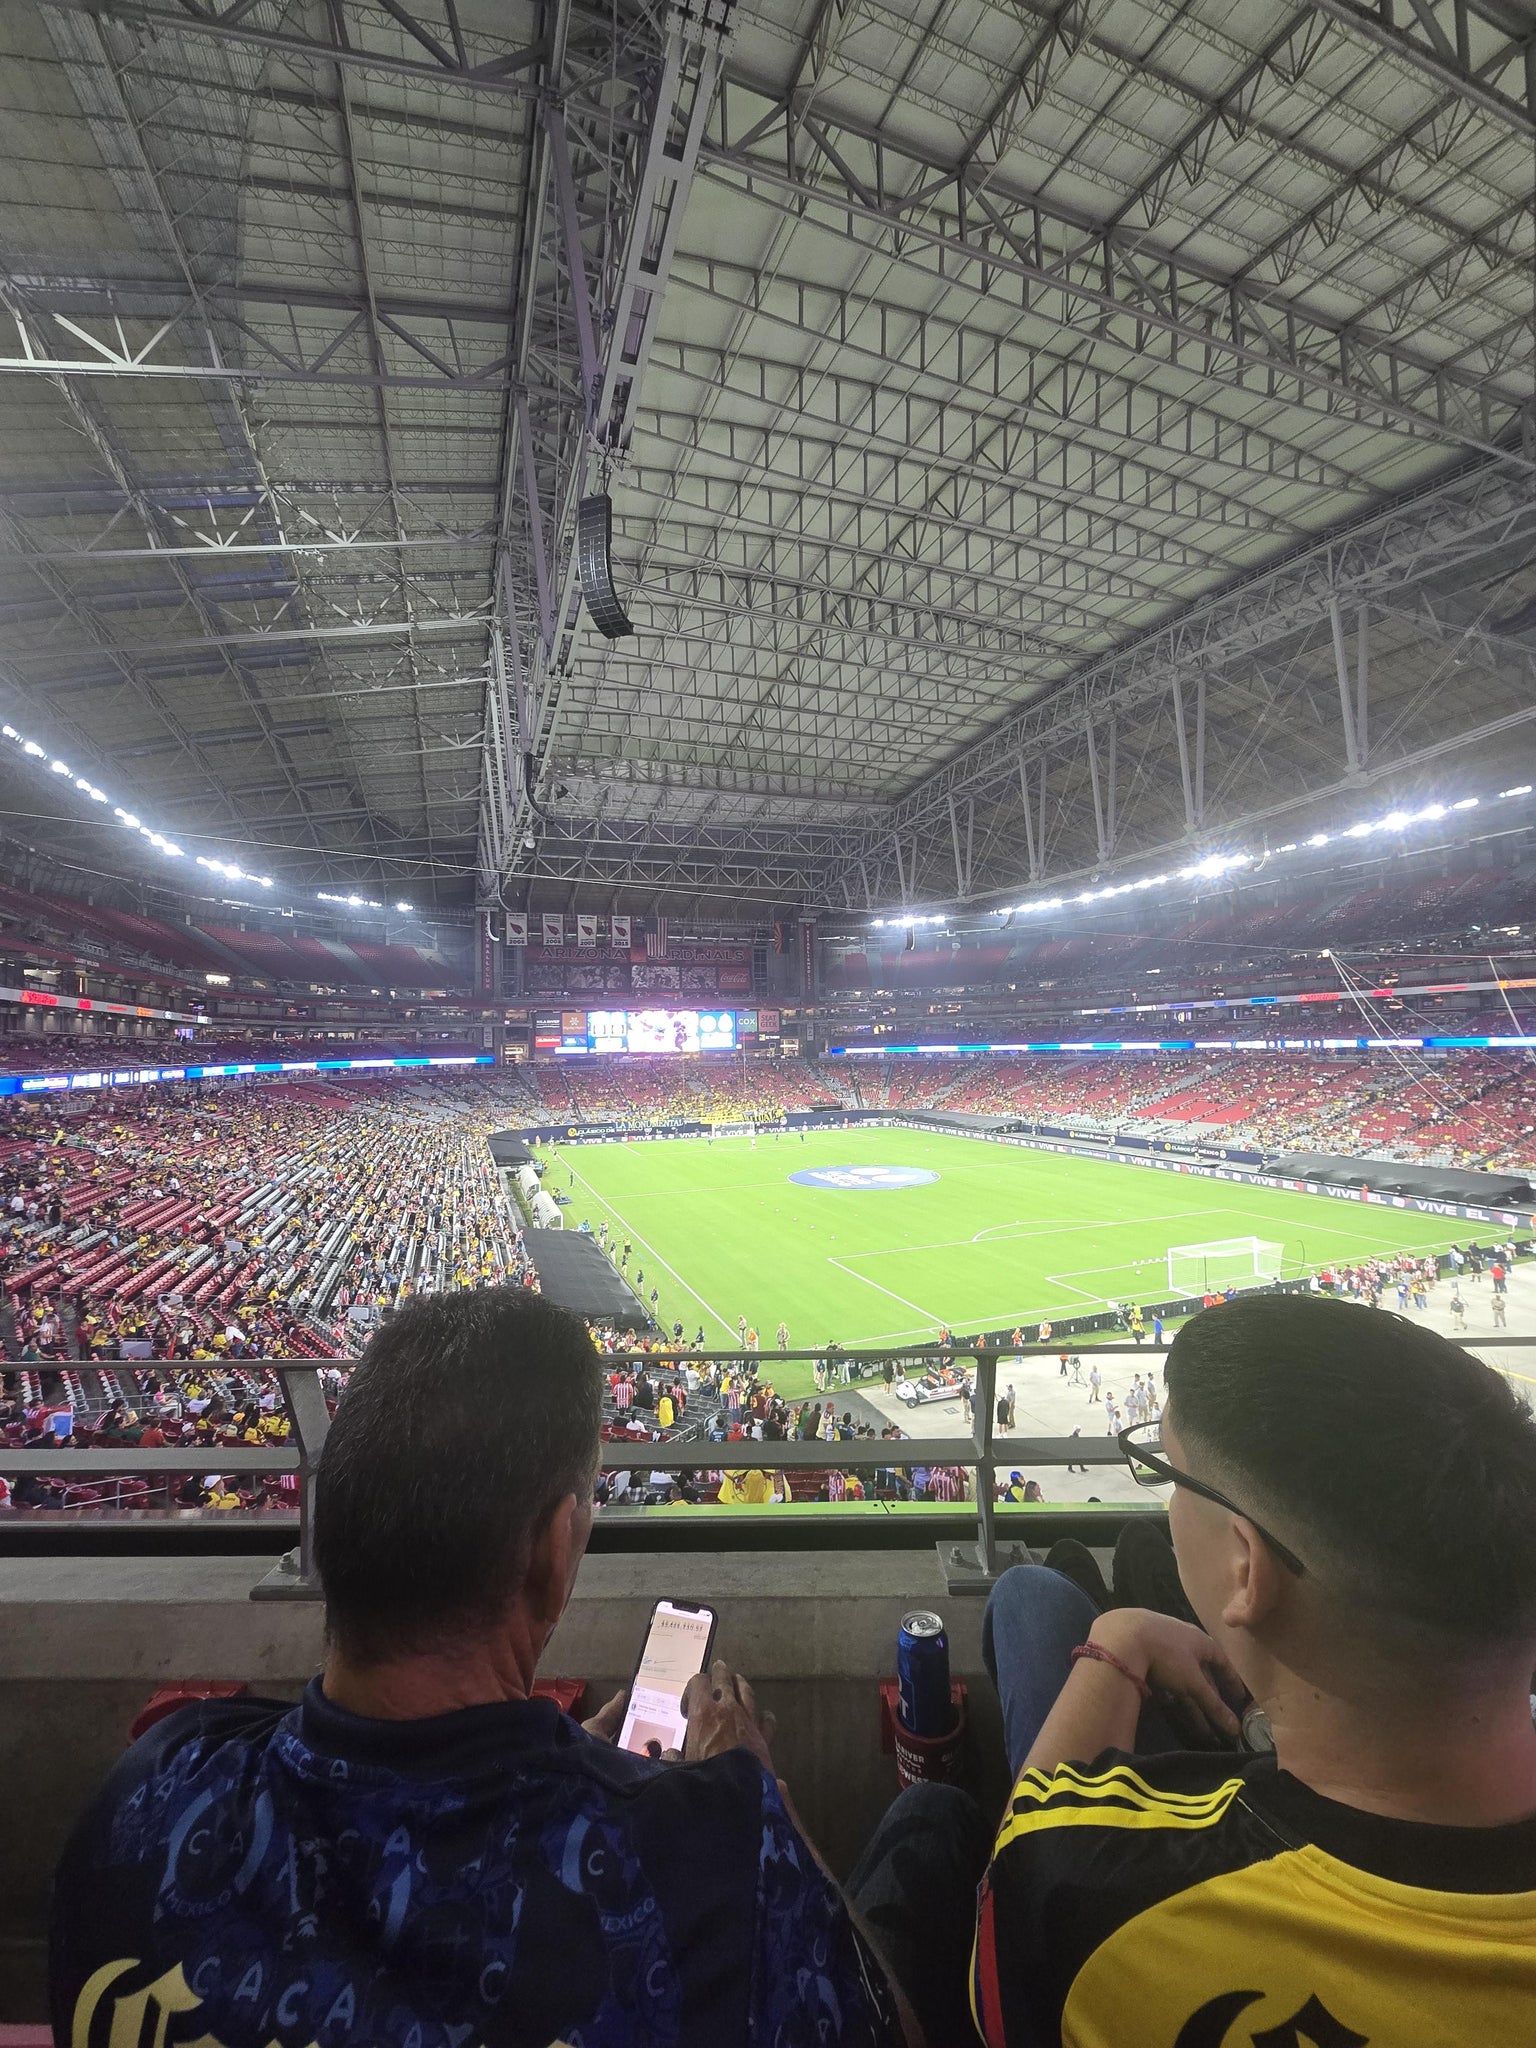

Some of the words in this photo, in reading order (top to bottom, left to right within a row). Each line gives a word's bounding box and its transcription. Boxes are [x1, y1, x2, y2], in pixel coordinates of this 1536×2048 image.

[540, 947, 627, 960] ARIZONA
[629, 1118, 684, 1130] MONUMENTAL
[1131, 1157, 1151, 1167] VIVE
[1187, 1166, 1210, 1176] VIVE
[1216, 1170, 1229, 1180] EL
[1248, 1174, 1278, 1188] VIVE
[1283, 1180, 1298, 1192] EL
[1326, 1187, 1360, 1201] VIVE
[1367, 1193, 1387, 1205] EL
[1415, 1200, 1457, 1216] VIVE
[1466, 1208, 1490, 1221] EL
